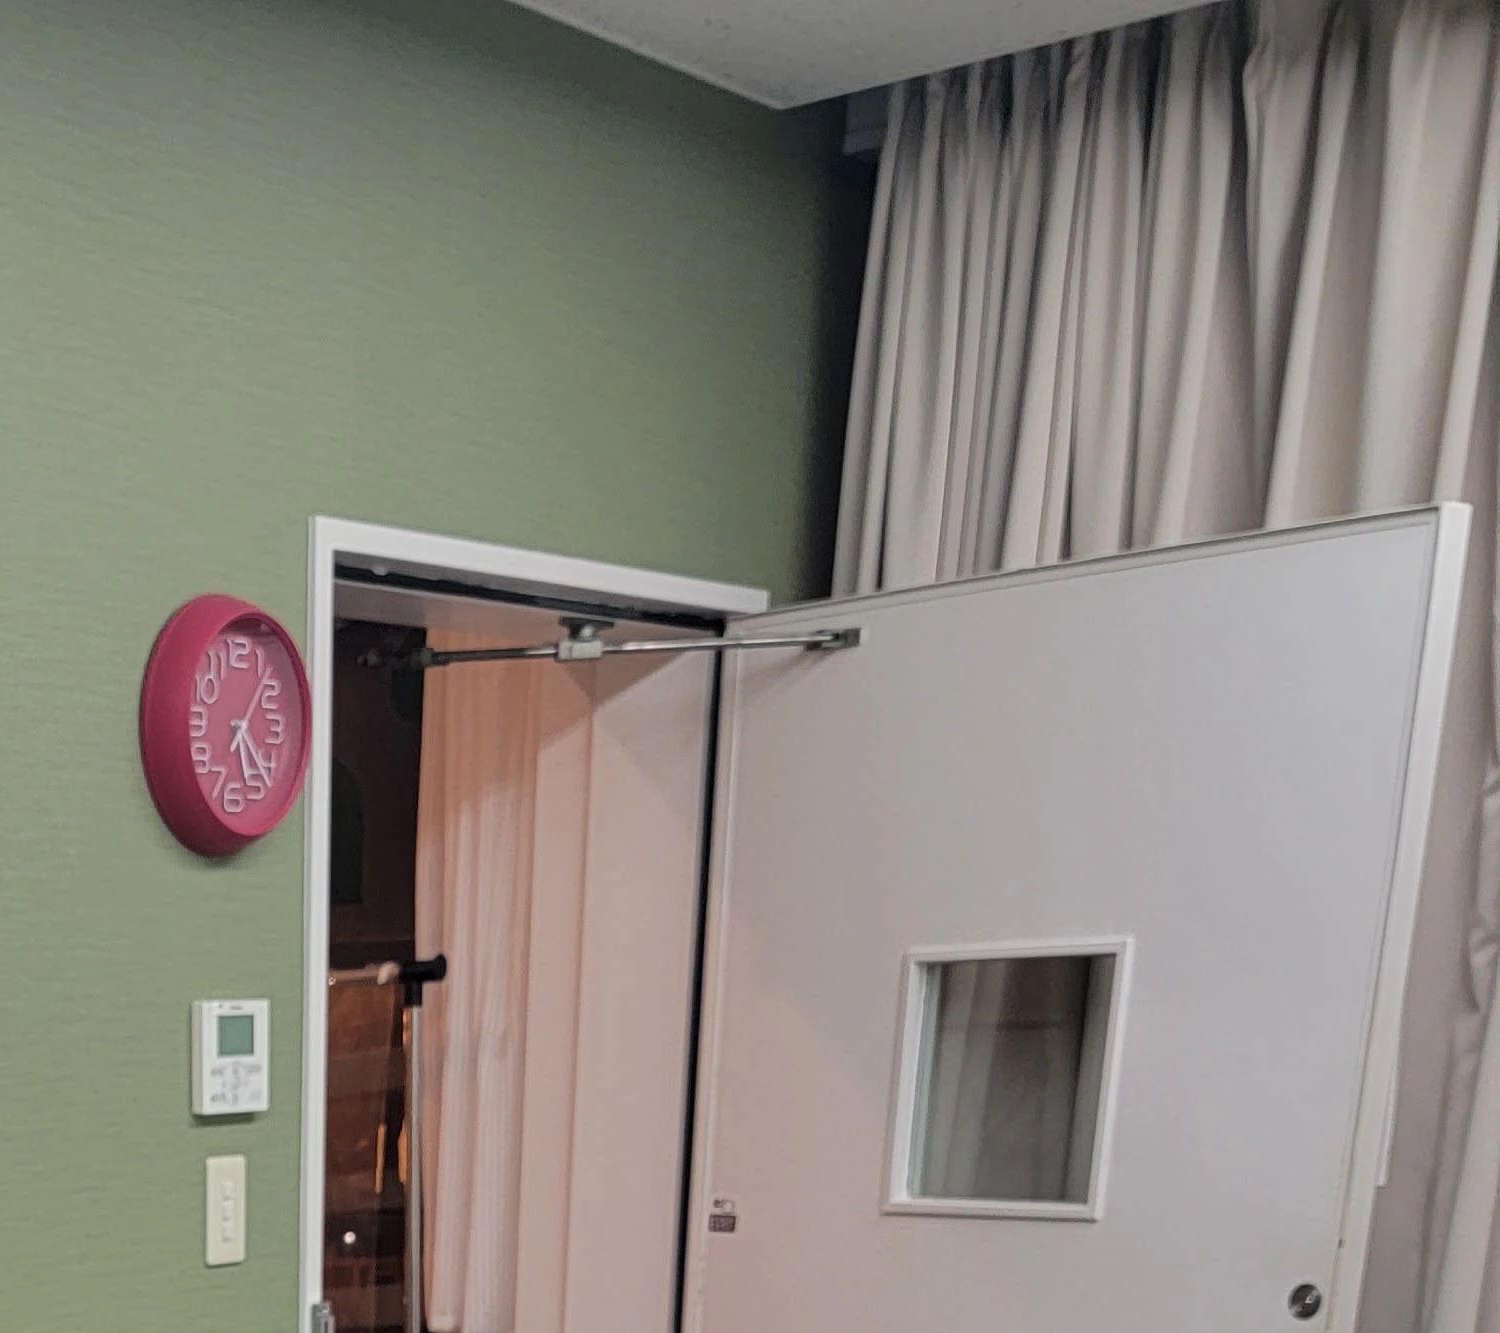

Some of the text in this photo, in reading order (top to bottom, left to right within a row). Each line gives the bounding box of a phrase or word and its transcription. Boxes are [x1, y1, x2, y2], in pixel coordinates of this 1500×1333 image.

[228, 638, 250, 669] 12
[196, 675, 220, 705] 10
[261, 680, 282, 710] 2
[265, 713, 285, 745] 3
[210, 766, 228, 800] 7
[223, 782, 245, 814] 6
